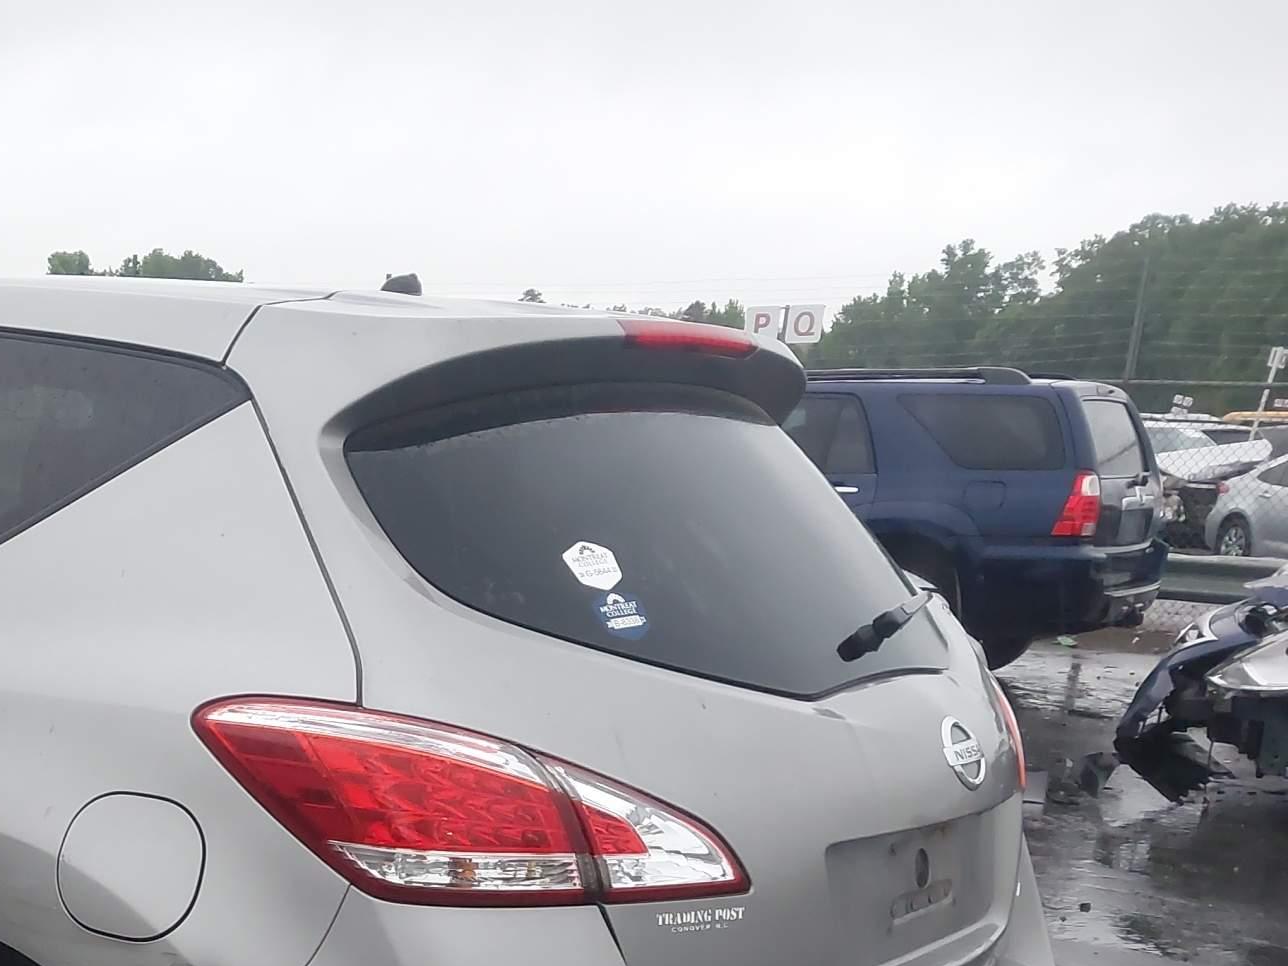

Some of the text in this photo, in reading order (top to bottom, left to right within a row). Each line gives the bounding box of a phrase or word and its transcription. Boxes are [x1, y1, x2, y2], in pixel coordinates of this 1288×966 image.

[753, 312, 771, 334] P
[793, 311, 815, 337] Q
[656, 906, 745, 926] TRADING POST
